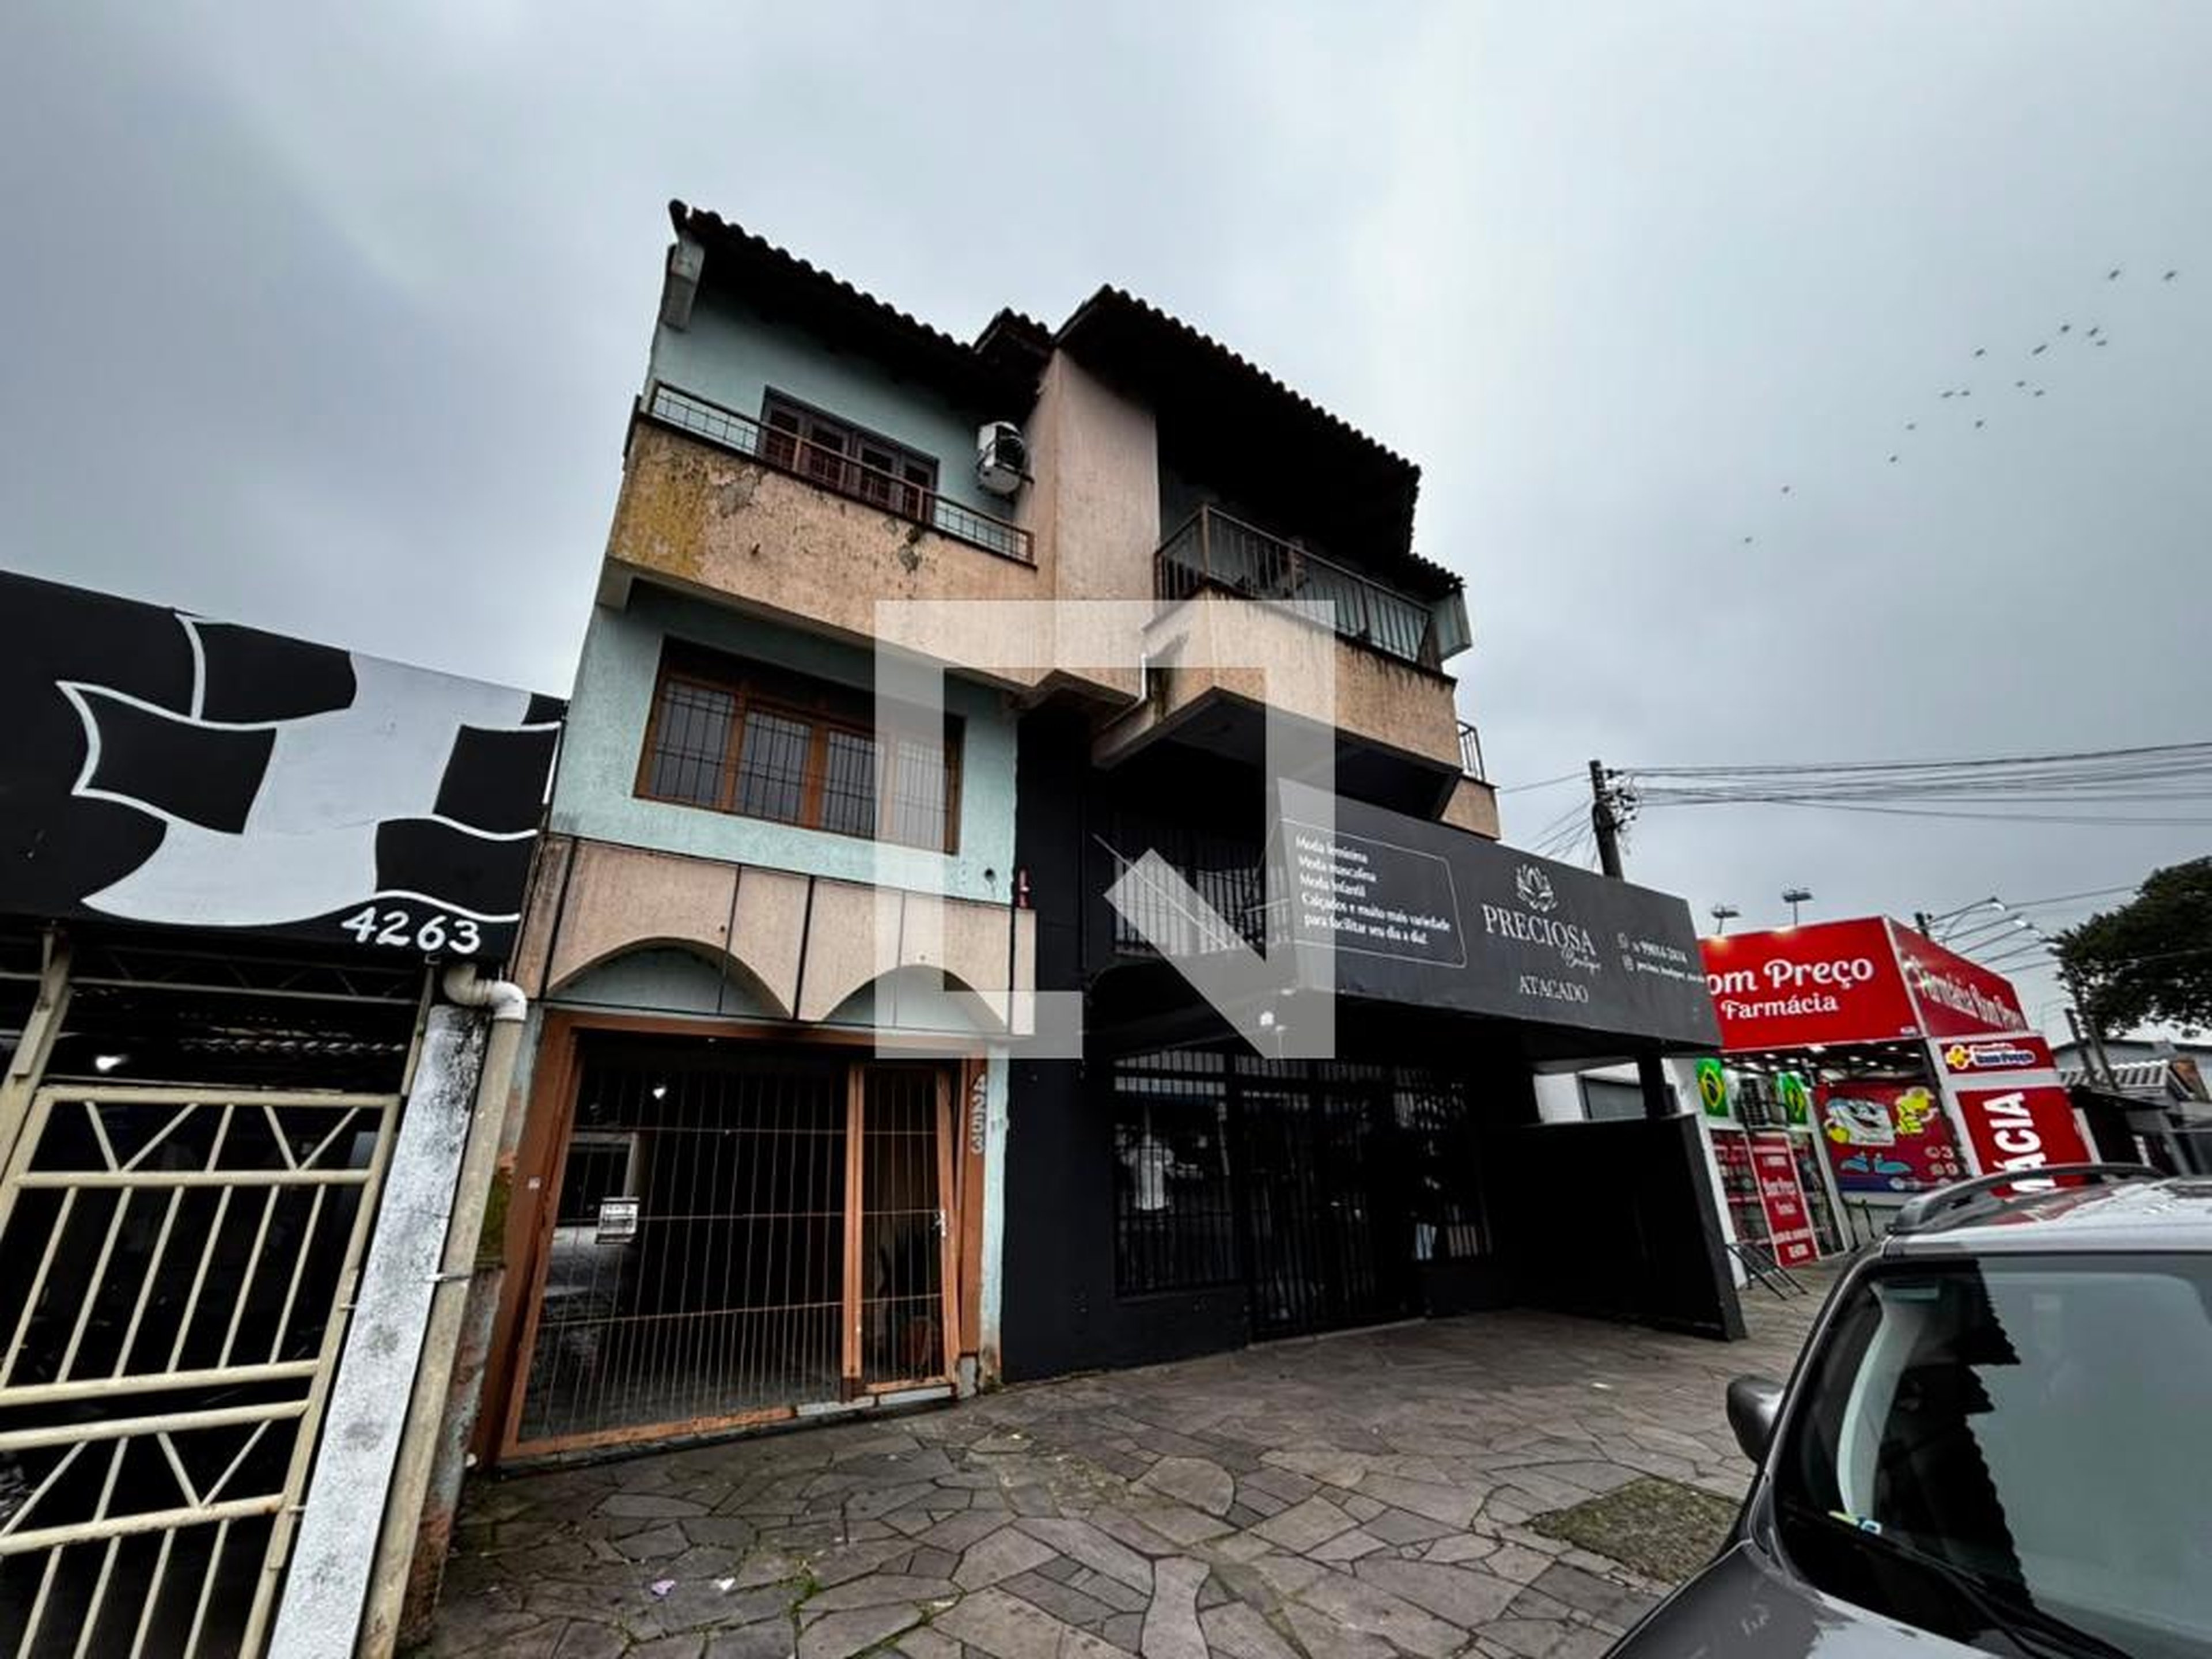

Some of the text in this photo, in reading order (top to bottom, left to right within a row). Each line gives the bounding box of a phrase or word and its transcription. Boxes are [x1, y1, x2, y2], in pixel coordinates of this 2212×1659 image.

[341, 906, 481, 954] 4263
[1482, 903, 1596, 956] PRECIOSA
[1520, 975, 1589, 1003] ATACADO
[1706, 970, 1759, 996] om
[1763, 958, 1874, 990] Preço
[1721, 993, 1840, 1020] Farmácia
[1982, 1092, 2056, 1194] ÁCIA
